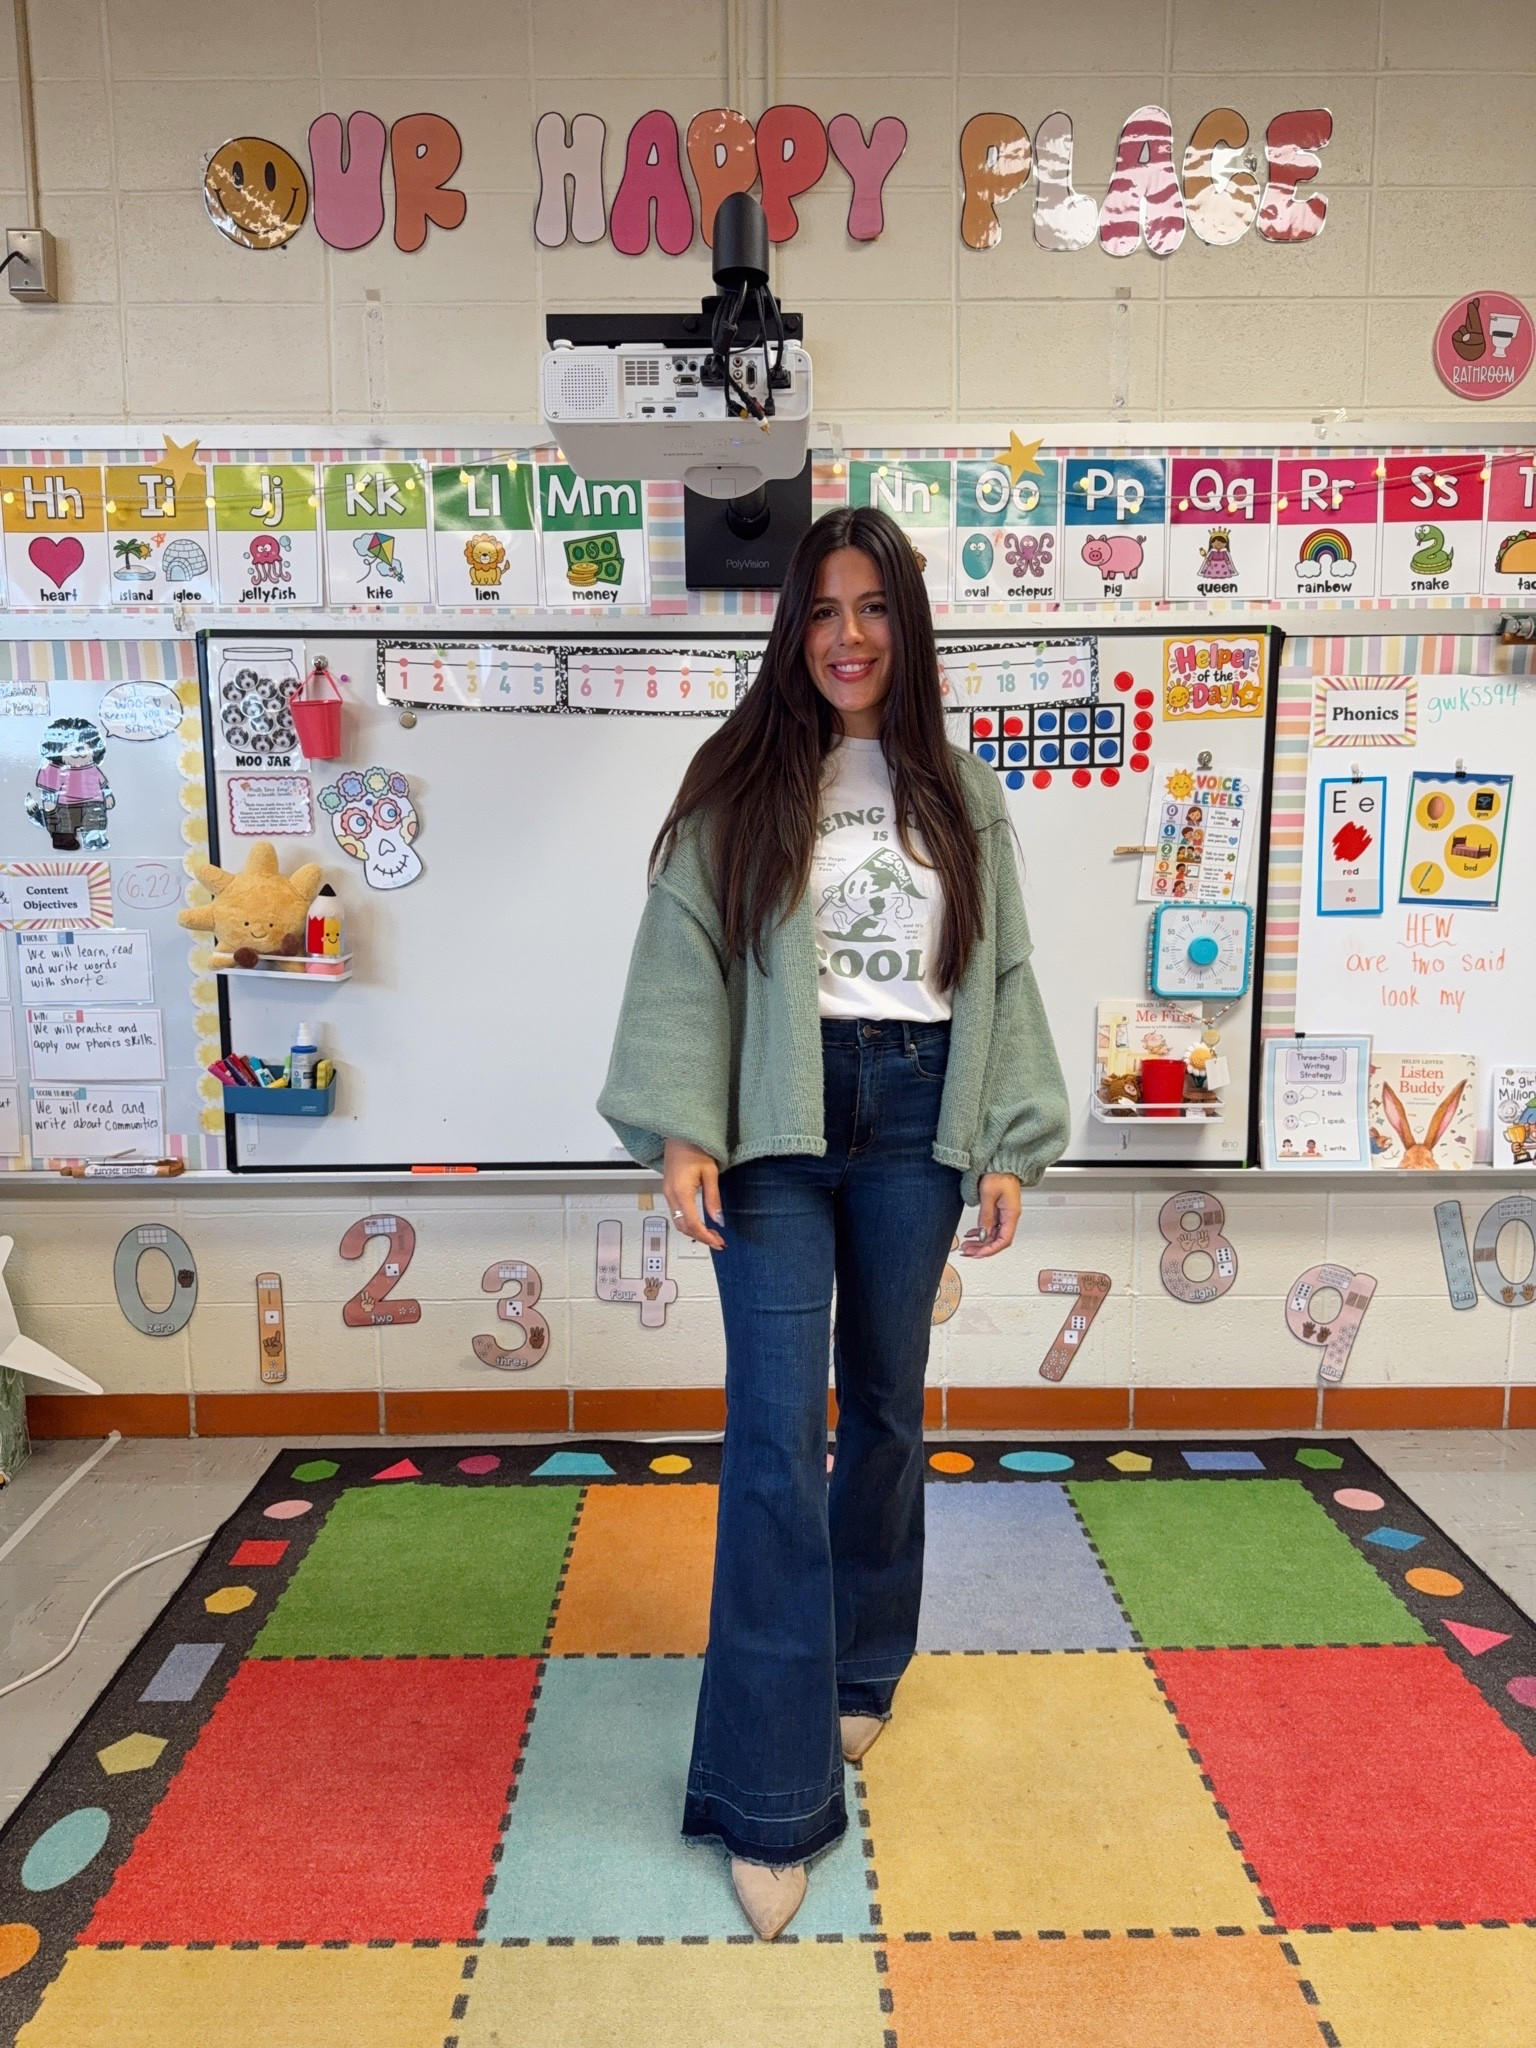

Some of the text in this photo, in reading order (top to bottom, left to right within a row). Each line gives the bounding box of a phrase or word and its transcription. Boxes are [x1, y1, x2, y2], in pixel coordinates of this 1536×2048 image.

[534, 105, 907, 256] HAPPY
[960, 105, 1333, 257] PLACE
[1453, 365, 1515, 384] BATHROOM
[870, 469, 931, 514] Nn
[974, 470, 1040, 513] Oo
[1086, 468, 1146, 521] Pp
[1188, 468, 1255, 520] Qq
[1300, 468, 1356, 512] Rr
[1410, 466, 1459, 508] Ss
[22, 475, 85, 519] Hh
[137, 474, 176, 518] Ii
[250, 474, 283, 526] Jj
[345, 473, 406, 517] Kk
[467, 473, 500, 517] Ll
[547, 474, 637, 518] Mm
[726, 559, 770, 570] PolyVision
[964, 585, 1053, 600] oval octopus
[1104, 584, 1122, 598] pig
[1197, 582, 1238, 596] queen
[1297, 580, 1352, 594] rainbow
[1411, 578, 1449, 592] snake
[40, 588, 77, 602] heart
[119, 588, 202, 603] island igloo
[239, 587, 296, 603] jellyfish
[366, 586, 393, 600] kite
[475, 587, 500, 601] lion
[572, 588, 618, 603] money
[1174, 643, 1256, 674] Helper
[400, 671, 544, 696] 1 2 3 4 5
[965, 669, 1085, 695] 17 18 19 20
[1198, 670, 1233, 682] of the
[580, 678, 728, 700] 6 7 8 9 10
[1193, 681, 1239, 709] Day!
[1332, 706, 1399, 721] Phonics
[236, 756, 291, 767] MOO JAR
[1196, 775, 1241, 792] VOICE
[1193, 791, 1243, 807] LEVELS
[1333, 790, 1374, 813] E e
[816, 807, 886, 839] EING
[872, 831, 888, 842] IS
[1343, 868, 1359, 876] red
[1463, 863, 1478, 872] bed
[26, 886, 69, 895] Content
[23, 900, 78, 910] Objectives
[1406, 912, 1455, 944] HFW
[27, 943, 133, 961] We will learn, read
[25, 959, 117, 975] and write words
[1346, 948, 1506, 975] are two said
[31, 973, 92, 988] with short
[1382, 985, 1465, 1014] look my
[1136, 1010, 1197, 1023] Me First
[33, 1022, 137, 1037] We will practice and
[33, 1040, 58, 1054] apply
[65, 1041, 80, 1050] our
[86, 1038, 121, 1052] phonics
[1296, 1053, 1337, 1062] Three-Step
[1303, 1062, 1330, 1071] Writing
[1401, 1065, 1444, 1079] Listen
[1300, 1071, 1332, 1080] Strategy
[1501, 1077, 1514, 1087] The
[1400, 1081, 1445, 1097] Buddy
[35, 1100, 145, 1115] We will read and
[35, 1116, 102, 1130] write about
[1158, 1190, 1238, 1304] 8
[1434, 1195, 1536, 1311] 10
[339, 1213, 421, 1327] 2
[596, 1216, 679, 1328] 4
[610, 1288, 636, 1300] four
[1047, 1283, 1080, 1293] seven
[1188, 1286, 1218, 1299] eight
[1453, 1291, 1473, 1302] ten
[370, 1314, 393, 1324] two
[471, 1260, 550, 1371] 3
[1285, 1263, 1378, 1382] 9
[147, 1323, 174, 1333] zero
[1038, 1269, 1112, 1382] 7
[495, 1355, 528, 1367] three
[263, 1370, 285, 1380] one
[1320, 1364, 1342, 1378] nine
